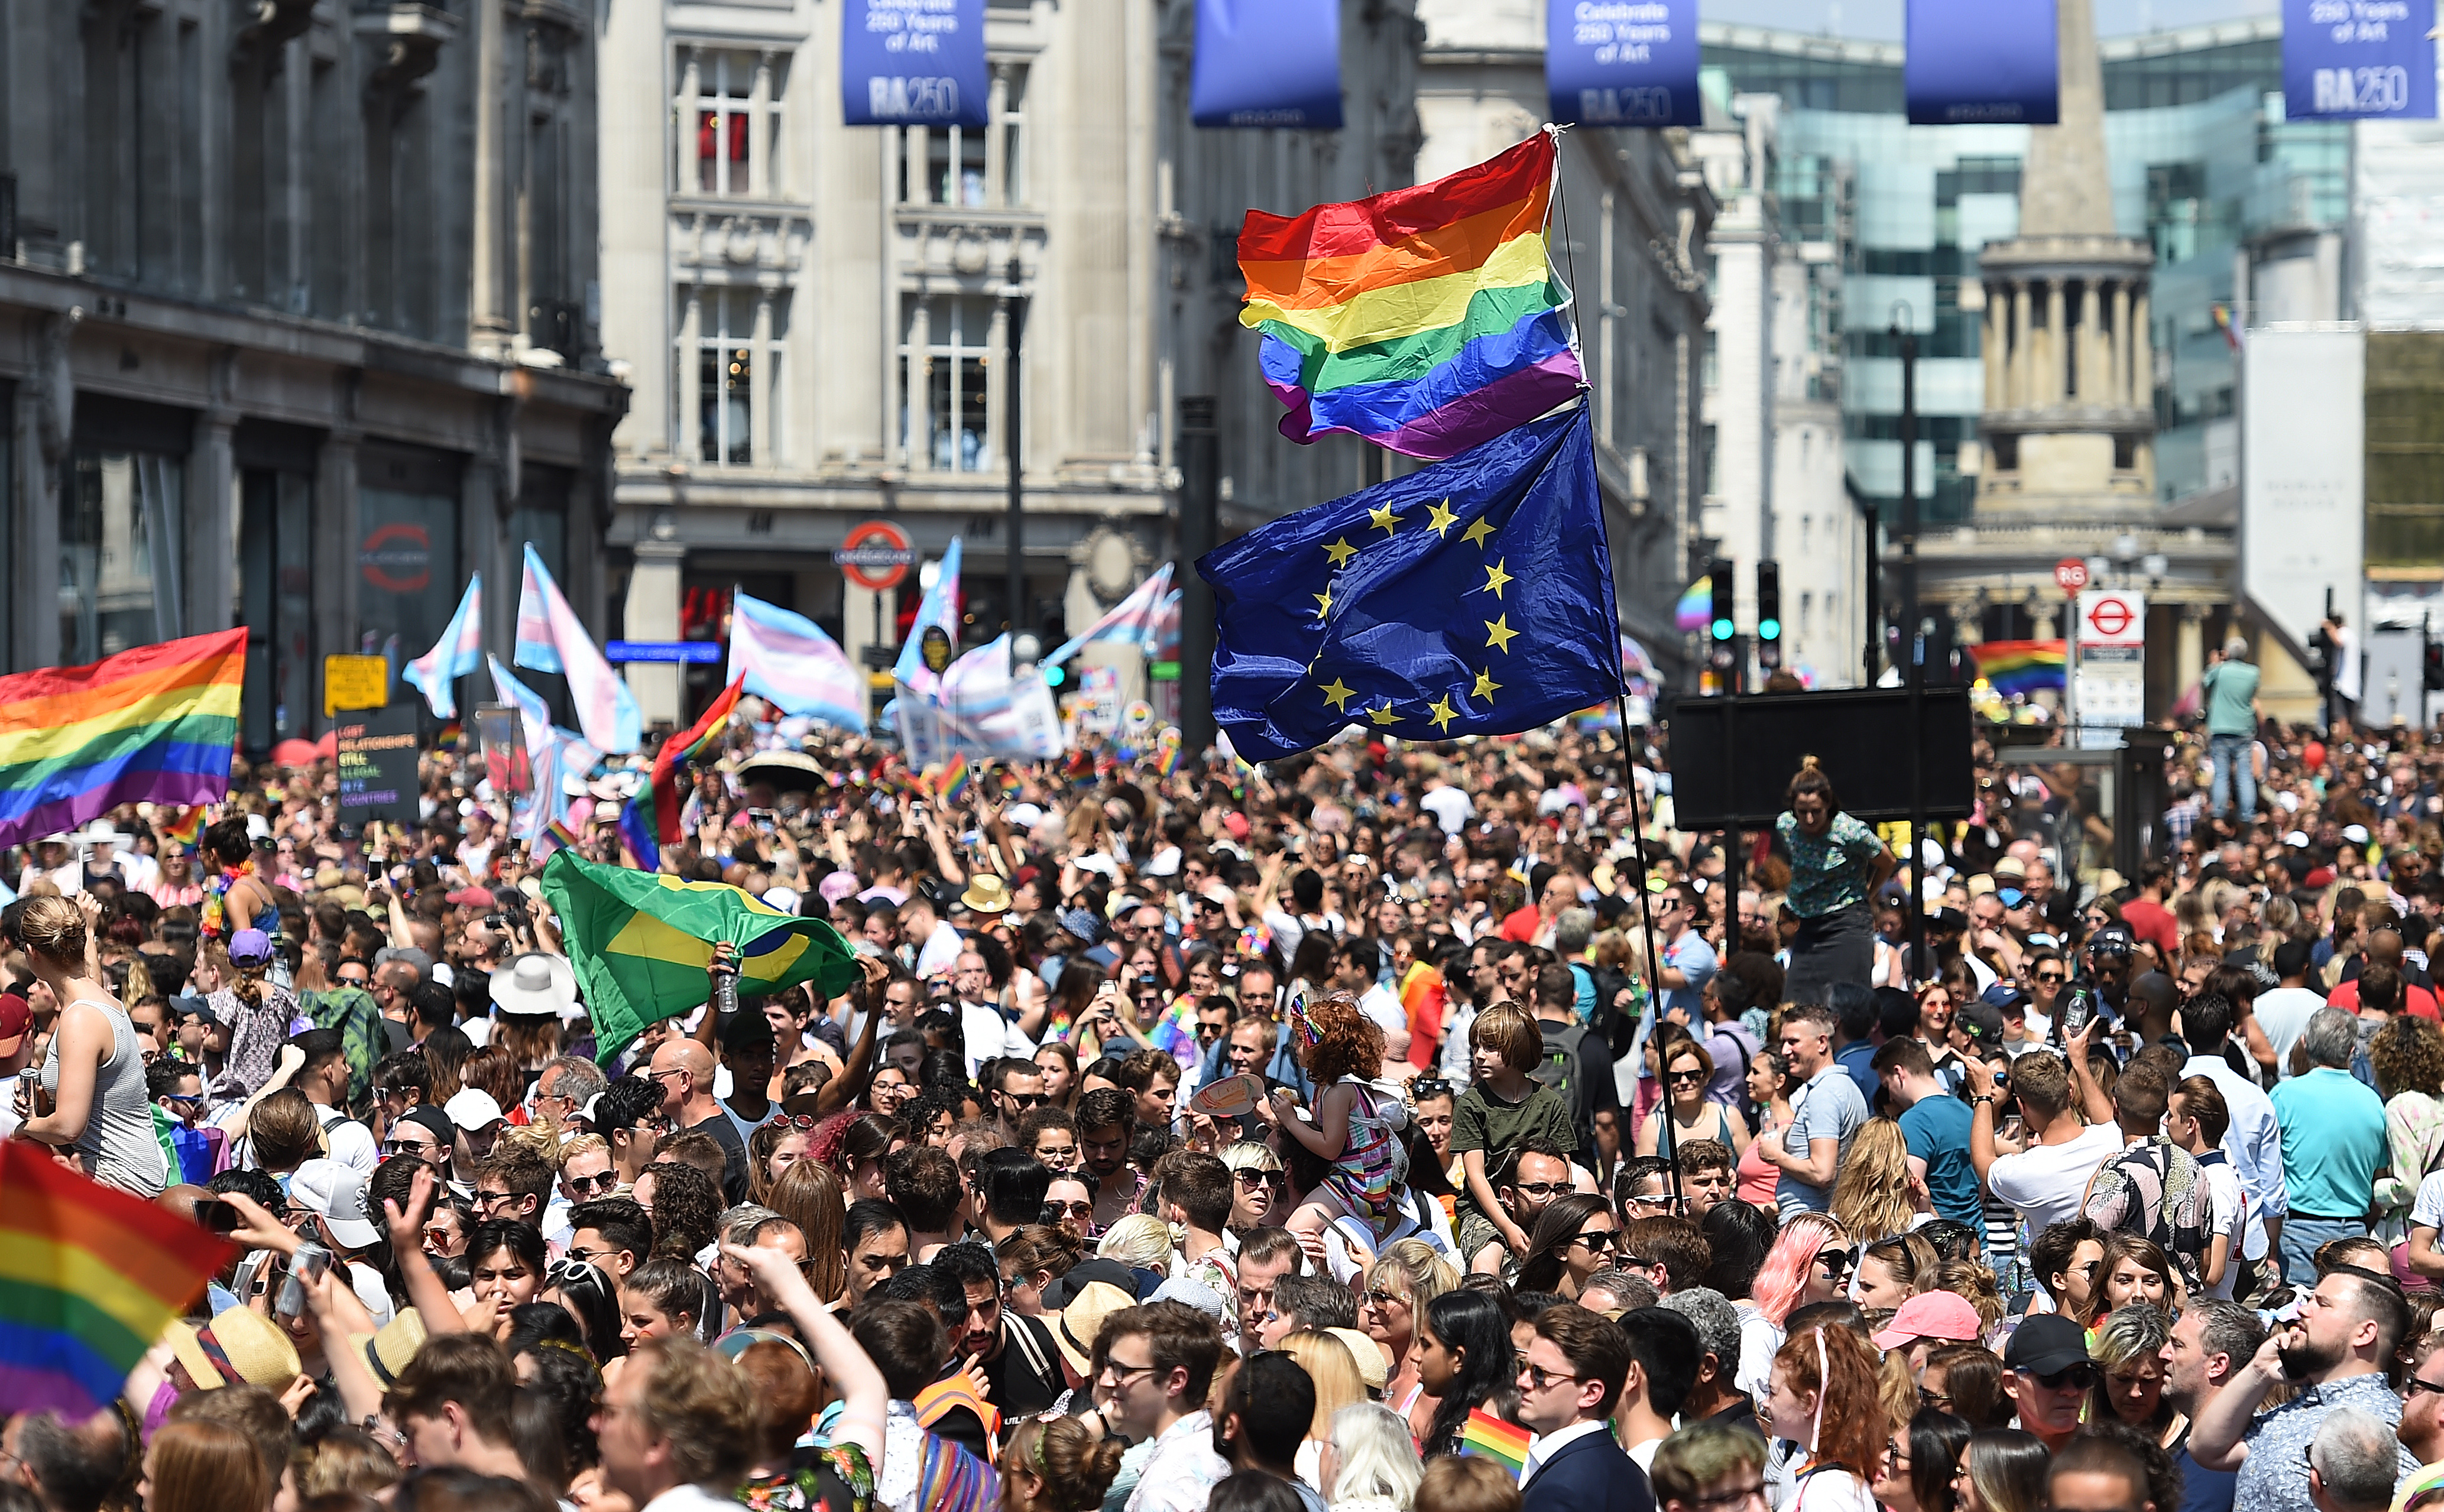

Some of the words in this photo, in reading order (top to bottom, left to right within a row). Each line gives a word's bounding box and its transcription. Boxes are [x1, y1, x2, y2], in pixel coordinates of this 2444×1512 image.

[866, 11, 905, 32] 250
[905, 11, 958, 33] Years
[1575, 2, 1668, 22] Celebrate
[2309, 1, 2350, 23] 250
[886, 31, 909, 53] of
[908, 31, 939, 53] Art
[1574, 23, 1613, 44] 250
[1614, 22, 1671, 43] Years
[2331, 21, 2355, 43] of
[2355, 20, 2389, 42] Art
[1594, 42, 1619, 64] of
[1619, 42, 1651, 64] Art
[868, 77, 960, 118] RA250
[2313, 66, 2408, 112] RA250
[1580, 87, 1672, 122] RA250
[339, 734, 417, 752] RELATIONSHIPS
[341, 790, 399, 807] COUNTRIES
